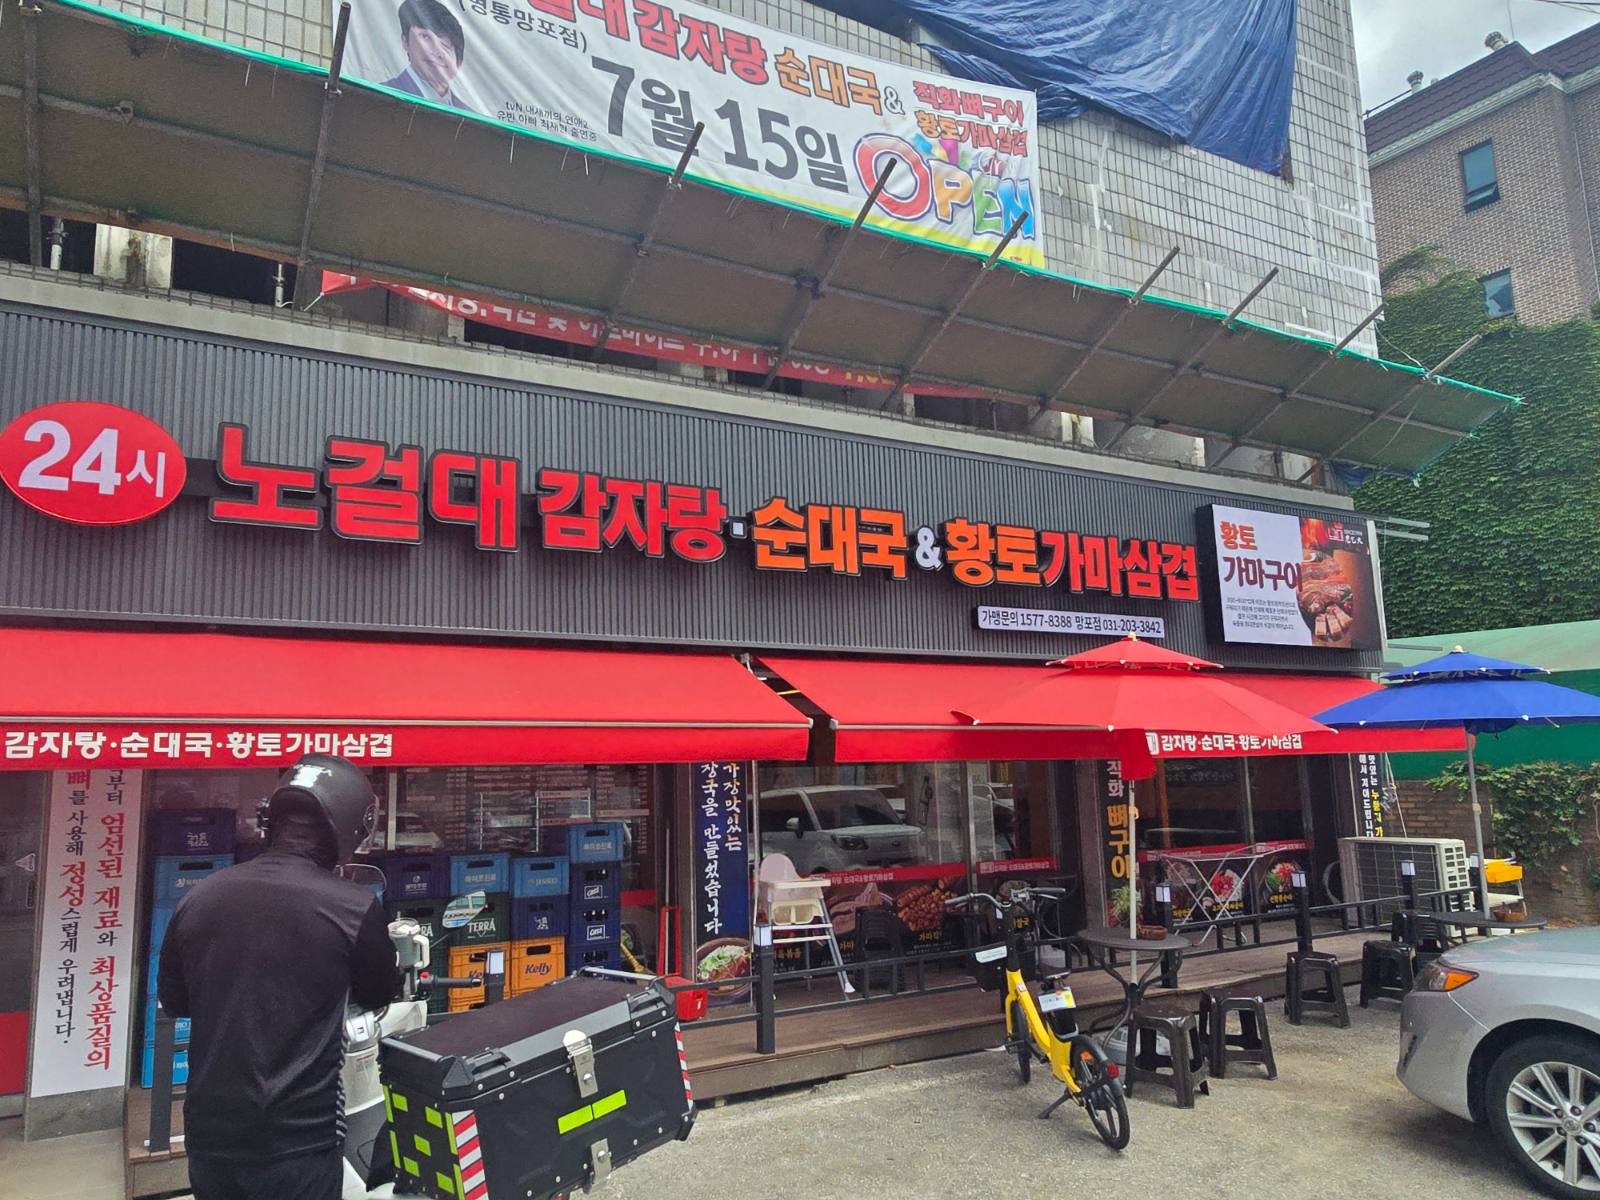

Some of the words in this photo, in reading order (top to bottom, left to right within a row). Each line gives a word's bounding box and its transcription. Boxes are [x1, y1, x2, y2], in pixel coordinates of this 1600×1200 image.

[775, 47, 882, 115] 순대국
[912, 80, 1024, 127] 직화뼈구이
[591, 55, 700, 157] 7월
[714, 99, 849, 193] 15일
[853, 133, 1035, 240] OPEN
[18, 419, 167, 498] 24시
[209, 424, 519, 551] 노걸대
[538, 468, 728, 561] 감자탕
[753, 497, 907, 579] 순대국
[945, 516, 1199, 601] 황토가마삼겹
[1219, 520, 1258, 550] 황토
[1222, 556, 1303, 592] 가마구이
[981, 609, 1019, 627] 가맹문의
[1020, 612, 1073, 629] 1577-8388
[1075, 615, 1101, 631] 망포점
[1103, 618, 1162, 634] 031-203-3842
[65, 809, 89, 857] 사용해
[97, 812, 125, 879] 엄선된
[724, 795, 742, 852] 맛있는
[57, 860, 87, 953] 정성스럽게
[703, 823, 723, 936] 만들었습니다
[93, 885, 124, 947] 재료와
[467, 917, 497, 934] TERRA
[524, 962, 552, 976] Kelly
[83, 955, 119, 1071] 최상품질의
